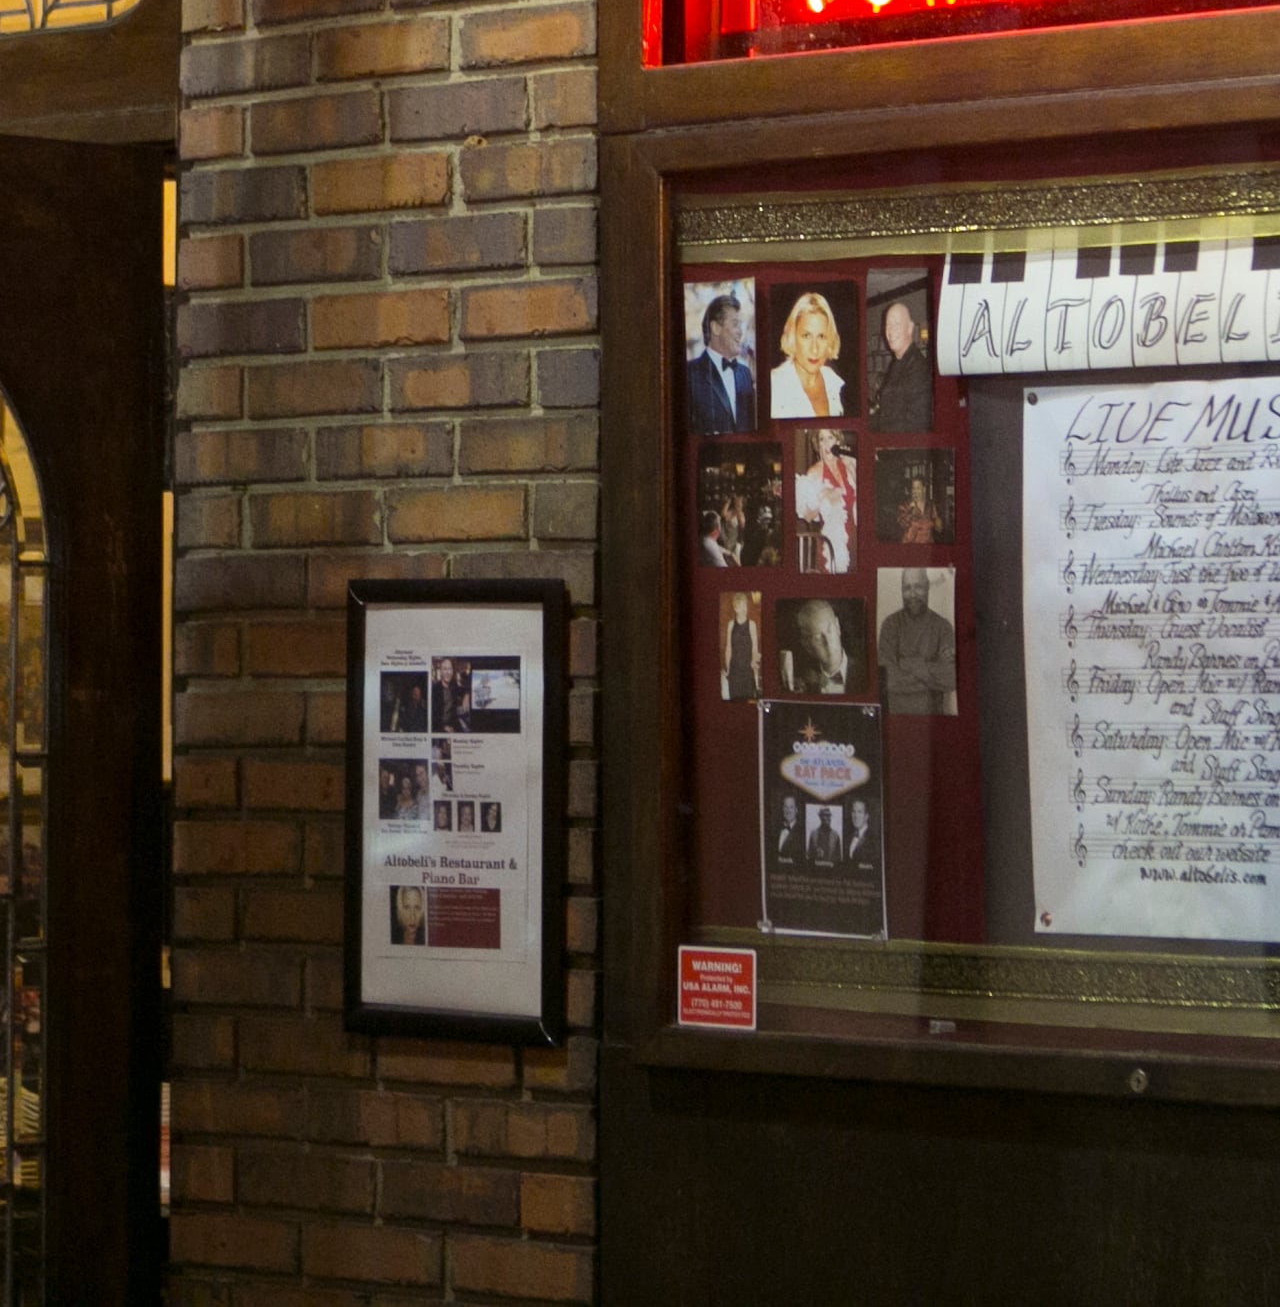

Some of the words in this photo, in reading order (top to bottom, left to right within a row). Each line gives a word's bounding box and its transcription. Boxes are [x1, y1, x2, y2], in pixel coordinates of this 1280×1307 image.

[1065, 395, 1193, 446] LIVE
[1135, 532, 1199, 560] Michael
[1091, 588, 1154, 616] Michael
[1141, 640, 1189, 672] Randy
[1147, 671, 1187, 705] Open
[1174, 723, 1213, 759] Open
[384, 854, 437, 869] Altobeli's
[439, 856, 505, 870] Restaurant
[508, 857, 519, 871] &
[421, 871, 456, 884] Piano
[457, 873, 481, 886] Bar
[691, 960, 743, 974] WARNING!
[682, 981, 701, 991] USA
